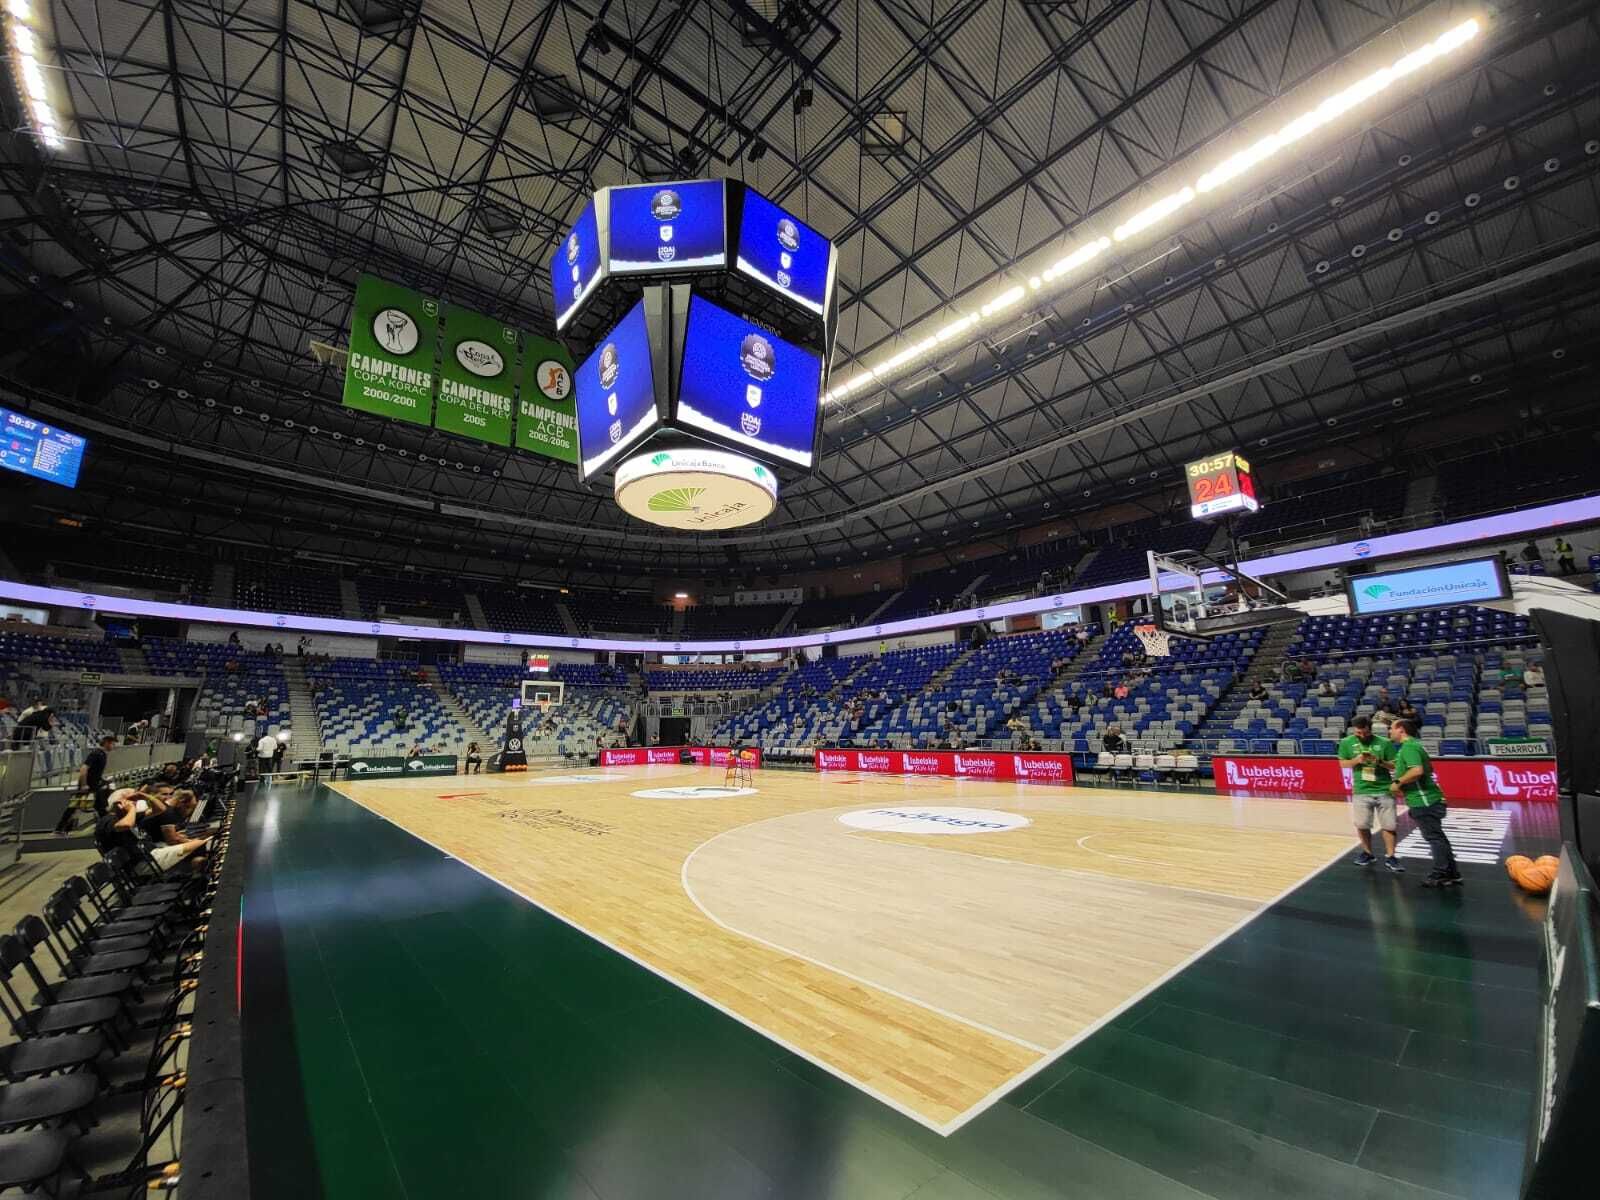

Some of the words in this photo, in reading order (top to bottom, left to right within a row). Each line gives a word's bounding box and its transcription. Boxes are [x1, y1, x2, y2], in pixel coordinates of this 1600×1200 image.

[351, 352, 432, 389] CAMPEONES
[354, 369, 387, 387] COPA
[388, 378, 427, 396] KORAC
[363, 386, 417, 408] 2000/2001
[441, 378, 512, 412] CAMPEONES
[440, 393, 468, 409] COPA
[469, 401, 489, 414] DEL
[491, 407, 511, 420] REY
[8, 414, 37, 431] 30:57
[463, 412, 487, 426] 2005
[528, 429, 570, 448] 2005/2006
[537, 421, 564, 438] ACB
[1189, 454, 1234, 477] 30:57
[1194, 472, 1233, 503] 24
[687, 501, 747, 522] Unicaja
[962, 758, 995, 767] lubelskie
[1024, 759, 1063, 770] lubelskie
[1241, 765, 1304, 778] lubelskie
[1250, 777, 1279, 788] Taste
[1281, 777, 1305, 790] life!
